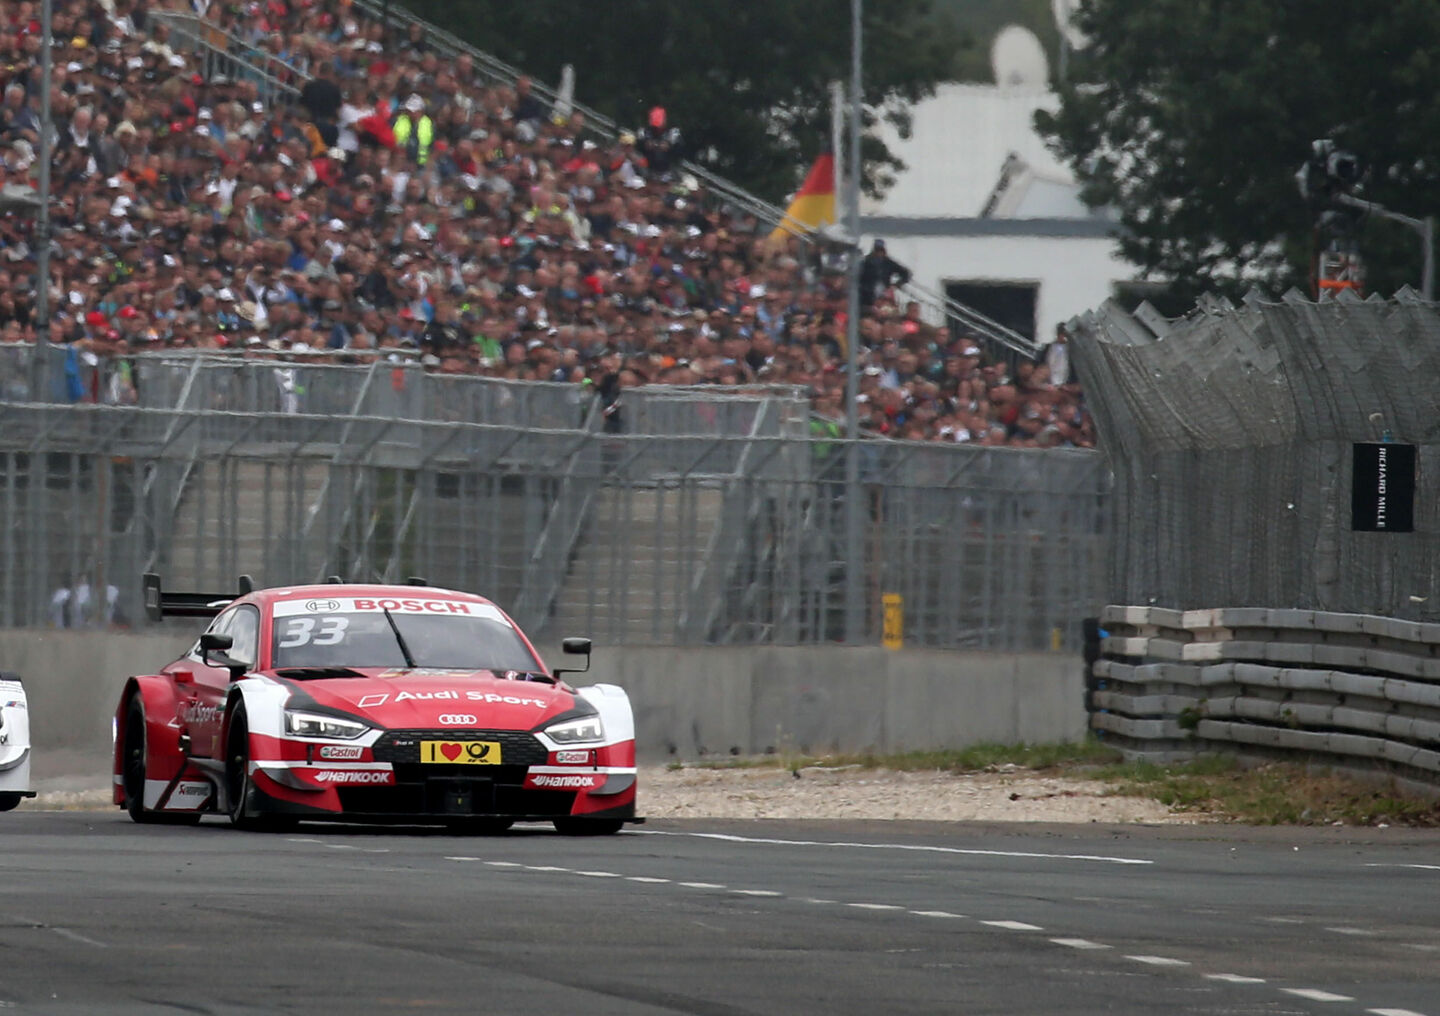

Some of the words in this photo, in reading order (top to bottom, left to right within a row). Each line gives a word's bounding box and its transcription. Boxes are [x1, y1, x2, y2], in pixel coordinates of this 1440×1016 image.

[353, 599, 471, 615] BOSCH
[279, 616, 350, 649] 33
[394, 690, 459, 702] Audi
[465, 690, 548, 709] Sport
[329, 746, 361, 758] Castrol
